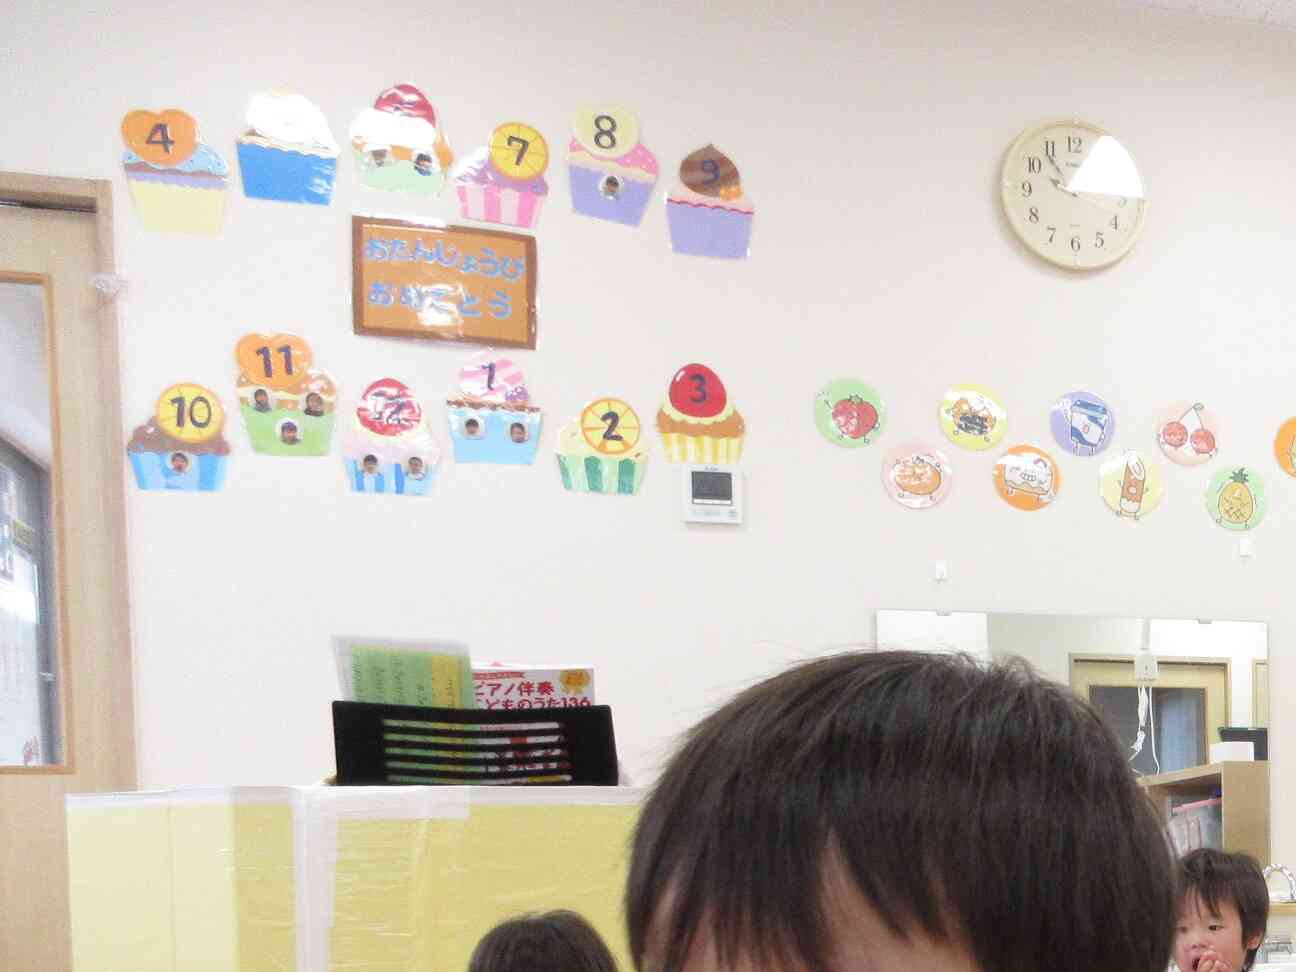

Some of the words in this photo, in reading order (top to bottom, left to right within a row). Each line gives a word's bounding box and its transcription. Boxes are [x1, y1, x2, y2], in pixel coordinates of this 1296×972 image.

[146, 123, 174, 153] 4
[594, 115, 617, 149] 8
[507, 136, 529, 166] 7
[1045, 141, 1056, 157] 11
[1067, 136, 1082, 153] 12
[702, 160, 720, 184] 9
[1028, 156, 1042, 174] 10
[1022, 181, 1032, 197] 9
[1029, 207, 1039, 224] 8
[1110, 215, 1119, 231] 4
[1046, 226, 1056, 243] 7
[1070, 235, 1081, 252] 6
[1095, 232, 1104, 248] 5
[365, 238, 526, 282] おたんじょうび
[255, 345, 293, 378] 11
[481, 363, 496, 390] 1
[689, 374, 707, 403] 3
[171, 396, 212, 428] 10
[601, 411, 624, 441] 2
